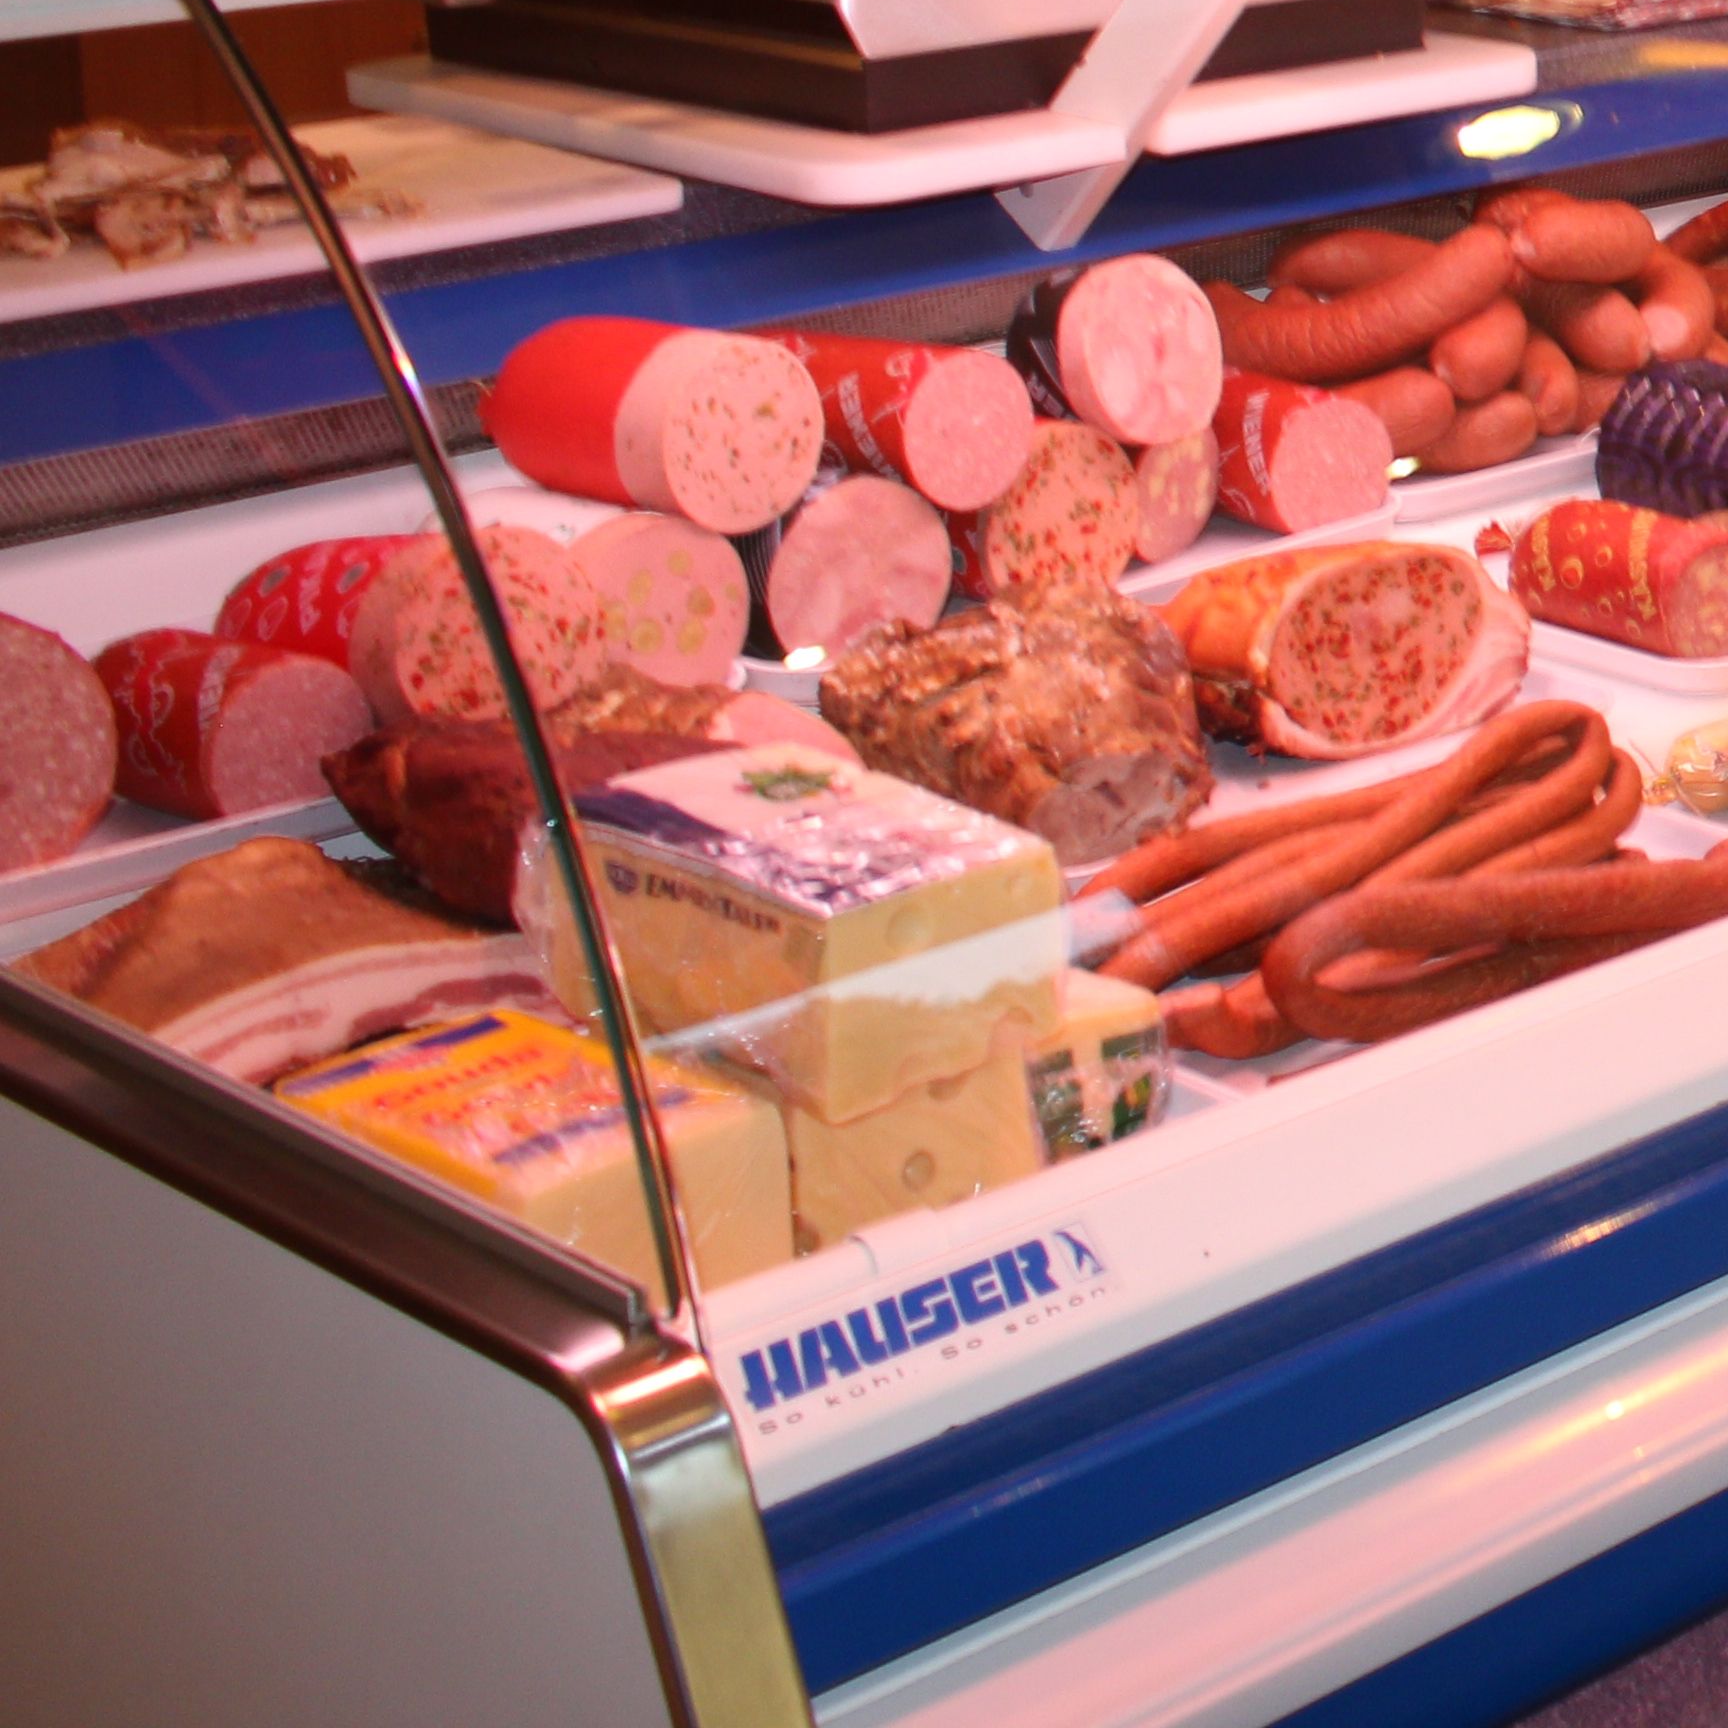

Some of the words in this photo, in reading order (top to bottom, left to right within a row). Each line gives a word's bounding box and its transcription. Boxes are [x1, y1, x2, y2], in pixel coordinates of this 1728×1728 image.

[740, 1239, 1059, 1412] HAUSER
[758, 1411, 803, 1434] So
[940, 1337, 984, 1360] So
